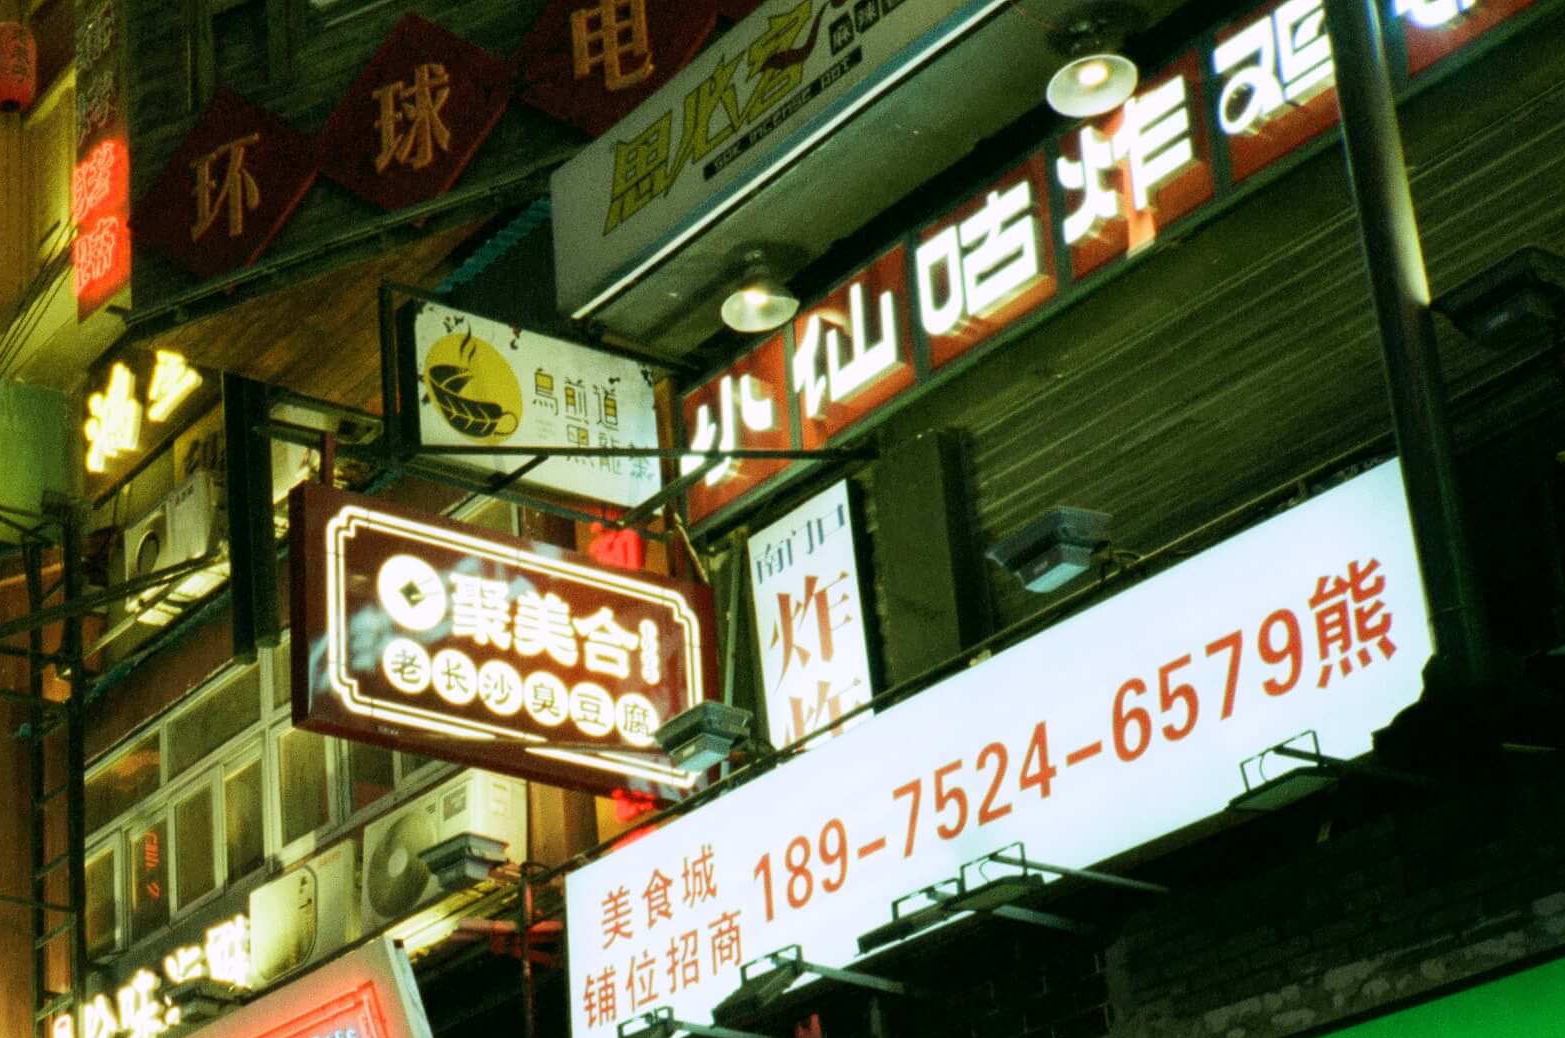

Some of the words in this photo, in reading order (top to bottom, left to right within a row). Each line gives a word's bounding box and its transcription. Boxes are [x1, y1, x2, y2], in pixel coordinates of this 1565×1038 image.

[449, 572, 640, 680] 聚美合
[388, 645, 660, 742] 老长沙臭豆腐
[600, 844, 718, 950] 美食城
[582, 910, 745, 1031] 铺位招商
